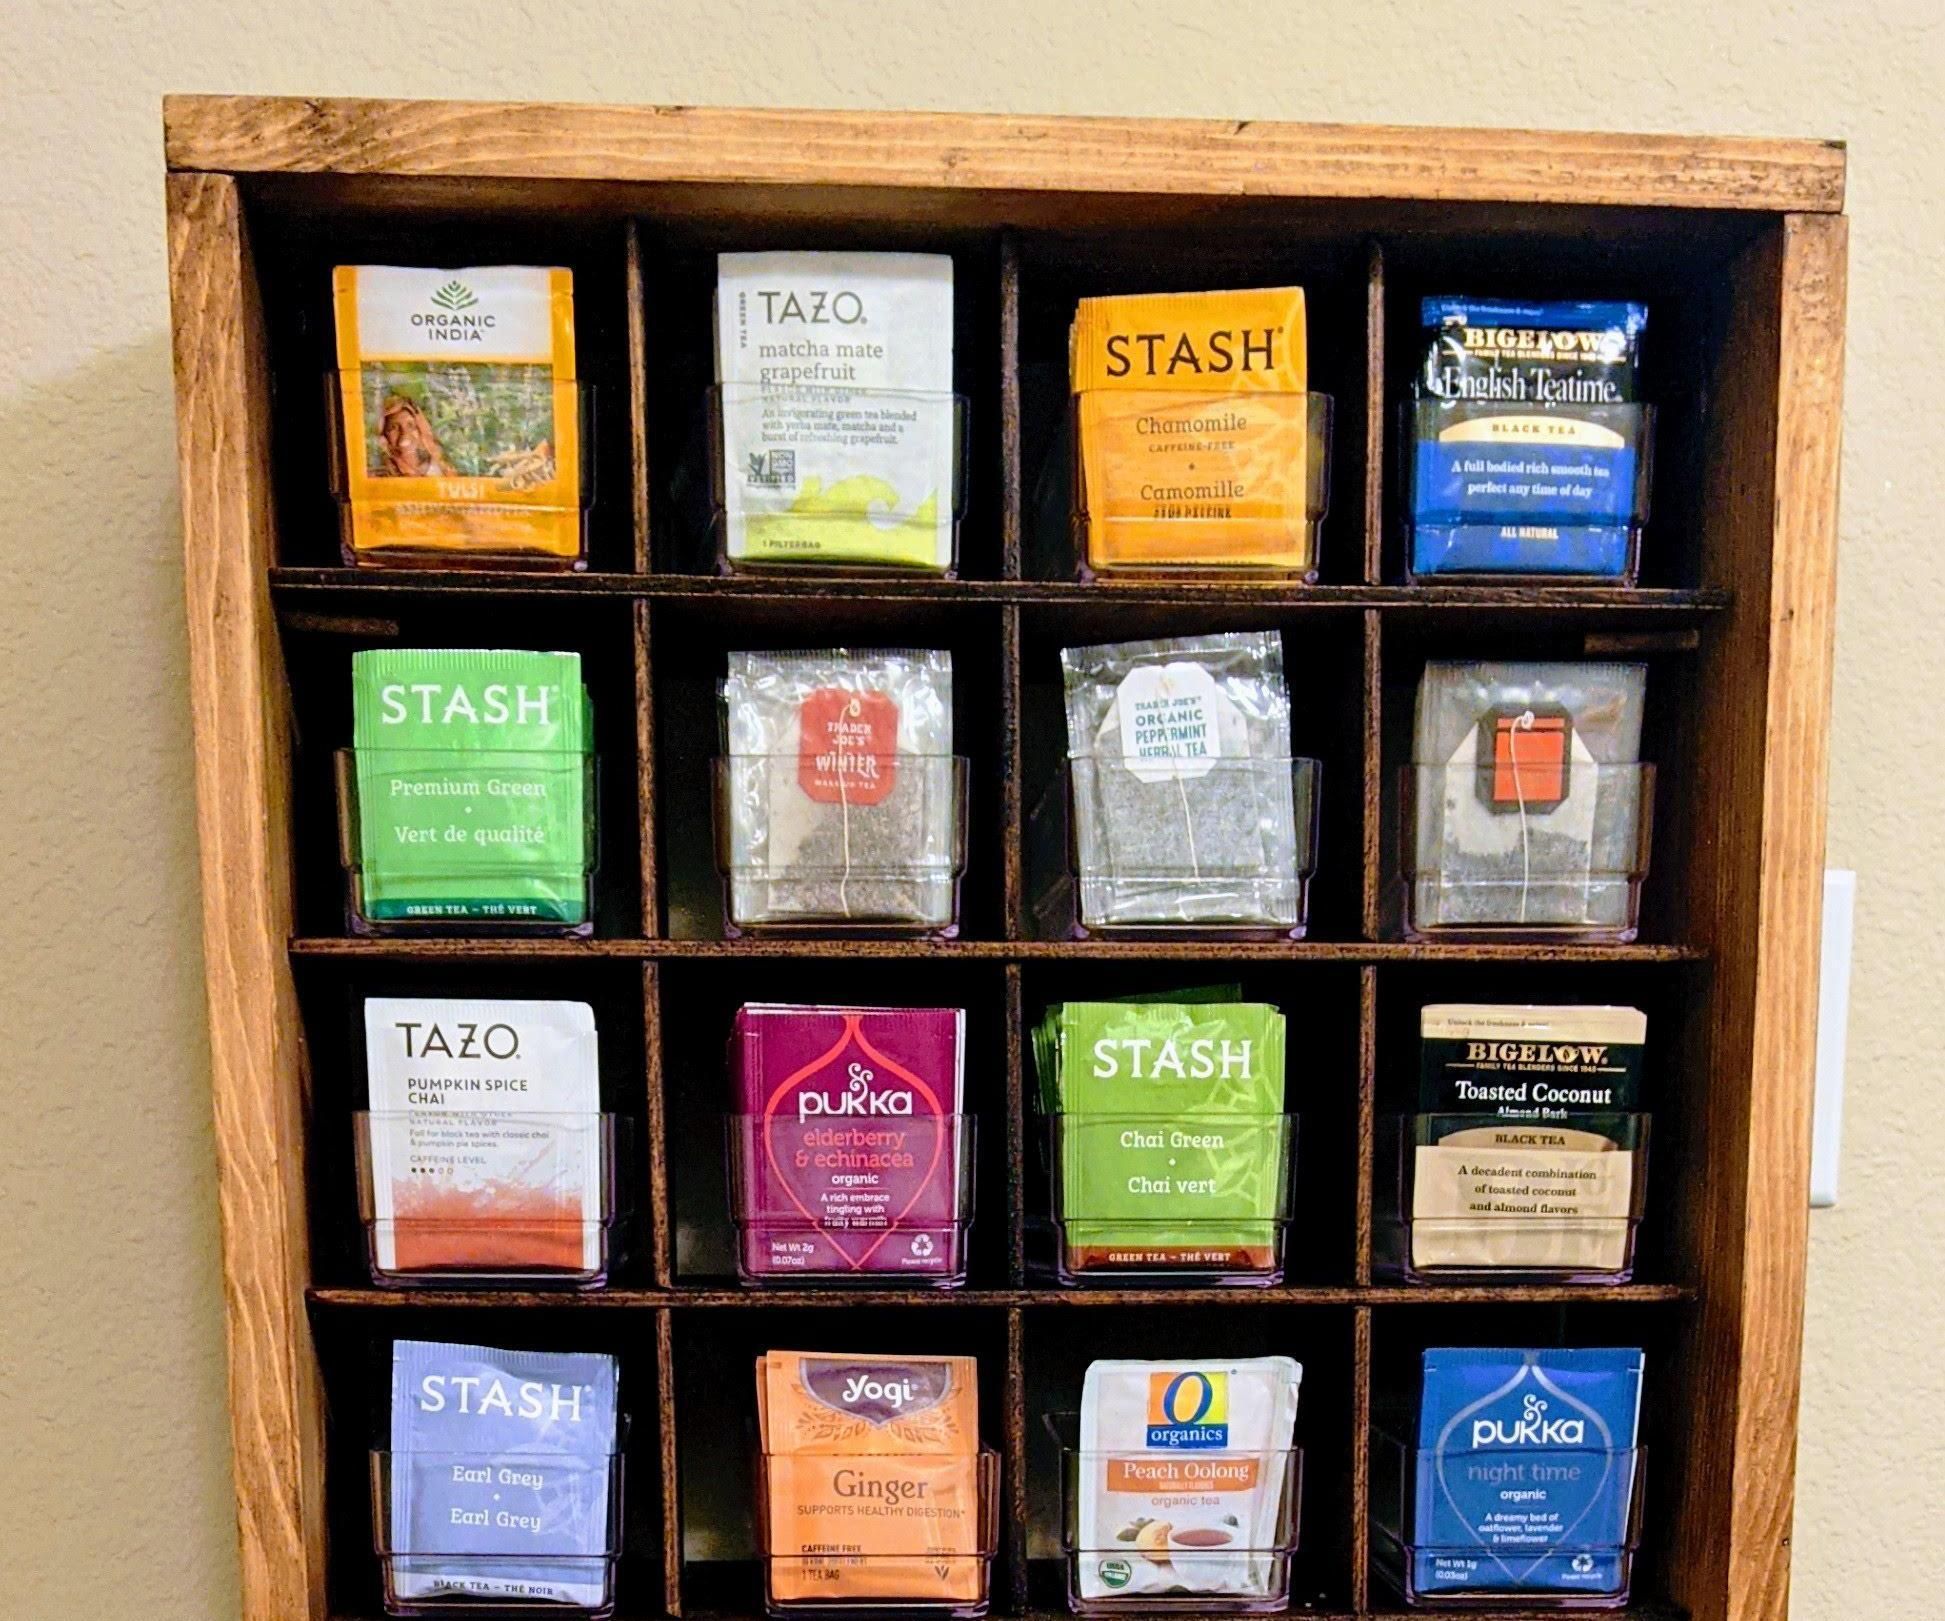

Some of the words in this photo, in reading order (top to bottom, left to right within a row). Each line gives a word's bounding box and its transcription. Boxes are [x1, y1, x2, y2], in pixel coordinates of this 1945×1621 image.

[757, 291, 863, 324] TAZO
[411, 314, 495, 328] ORGANIC
[428, 328, 481, 341] INDIA
[1463, 328, 1605, 351] BIGELOW
[759, 340, 829, 358] matcha
[836, 344, 884, 358] mate
[1107, 328, 1274, 377] STASH
[760, 362, 857, 385] grapefruit
[1444, 366, 1526, 404] English
[1530, 366, 1617, 403] Teatime
[836, 411, 862, 421] green
[864, 411, 878, 419] tea
[880, 410, 917, 421] blended
[1136, 413, 1247, 435] Chamomile
[762, 421, 784, 430] with
[842, 422, 876, 431] matcha
[879, 422, 896, 432] and
[1492, 424, 1540, 433] BLACK
[1549, 425, 1576, 434] TEA
[762, 432, 786, 442] burst
[788, 432, 798, 441] of
[1451, 460, 1461, 473] A
[1464, 459, 1485, 473] full
[1486, 460, 1524, 474] bodied
[1526, 461, 1549, 474] rich
[1551, 463, 1592, 476] smooth
[1140, 480, 1245, 501] Camomille
[1468, 482, 1507, 496] perfect
[1509, 485, 1531, 497] any
[1532, 483, 1557, 496] time
[1559, 484, 1572, 496] of
[1572, 485, 1593, 498] day
[1501, 526, 1517, 538] ALL
[1519, 528, 1559, 539] NATURAL
[381, 684, 550, 725] STASH
[1135, 709, 1203, 726] ORGANIC
[1135, 723, 1206, 744] PEPPRMINT
[1185, 741, 1207, 758] TEA
[816, 751, 880, 779] WINTER
[390, 778, 480, 797] Premium
[487, 779, 547, 797] Green
[394, 825, 438, 843] Vert
[444, 825, 467, 842] de
[474, 825, 545, 846] qualité
[406, 905, 443, 915] GREEN
[445, 905, 469, 915] TEA
[508, 905, 537, 915] VERT
[395, 1023, 519, 1059] TAZO
[1093, 1039, 1252, 1079] STASH
[1466, 1042, 1606, 1065] BIGELOW
[408, 1079, 480, 1091] PUMPKIN
[485, 1079, 528, 1091] SPICE
[799, 1063, 912, 1123] pukka
[1455, 1080, 1527, 1102] Toasted
[1532, 1083, 1612, 1104] Coconut
[408, 1093, 445, 1104] CHAI
[1497, 1106, 1540, 1119] Almond
[1542, 1107, 1568, 1120] Bark
[441, 1130, 463, 1138] black
[502, 1131, 530, 1139] classic
[532, 1131, 550, 1139] chai
[803, 1128, 906, 1148] elderberry
[1120, 1130, 1164, 1149] Chai
[1170, 1131, 1224, 1149] Green
[1495, 1134, 1539, 1144] BLACK
[1541, 1135, 1565, 1145] TEA
[418, 1140, 454, 1148] pumpkin
[456, 1140, 469, 1148] pie
[410, 1155, 455, 1164] CAFFEINE
[457, 1156, 487, 1164] LEVEL
[795, 1152, 809, 1168] &
[814, 1151, 914, 1169] echinacea
[831, 1173, 879, 1186] organic
[1458, 1165, 1468, 1175] A
[1471, 1166, 1522, 1178] decadent
[1525, 1168, 1596, 1180] combination
[1128, 1176, 1170, 1194] Chai
[1176, 1176, 1217, 1193] vert
[1474, 1184, 1486, 1195] of
[1486, 1185, 1529, 1196] toasted
[1532, 1187, 1576, 1197] coconut
[821, 1193, 829, 1202] A
[830, 1193, 848, 1202] rich
[850, 1193, 890, 1202] embrace
[826, 1205, 863, 1215] tingling
[864, 1205, 884, 1214] with
[1469, 1202, 1491, 1212] and
[1494, 1202, 1536, 1213] almond
[1540, 1203, 1578, 1214] flavors
[772, 1242, 787, 1251] Net
[802, 1243, 814, 1253] 2g
[1108, 1252, 1143, 1262] GREEN
[1146, 1252, 1166, 1261] TEA
[1204, 1252, 1231, 1261] VERT
[420, 1375, 582, 1422] STASH
[1163, 1371, 1213, 1425] O
[1472, 1394, 1584, 1448] pukka
[1152, 1426, 1223, 1444] organics
[453, 1466, 491, 1484] Earl
[499, 1468, 543, 1490] Grey
[1124, 1462, 1179, 1479] Peach
[1184, 1462, 1249, 1481] Oolong
[1468, 1461, 1524, 1485] night
[1532, 1461, 1581, 1481] time
[833, 1470, 928, 1505] Ginger
[1500, 1489, 1547, 1502] organic
[1152, 1496, 1196, 1508] organic
[1201, 1496, 1220, 1505] tea
[797, 1506, 853, 1516] SUPPORTS
[858, 1506, 903, 1516] HEALTHY
[1485, 1513, 1493, 1522] A
[1494, 1513, 1528, 1523] dreamy
[1530, 1513, 1547, 1522] bed
[1549, 1513, 1559, 1522] of
[450, 1508, 489, 1526] Earl
[497, 1511, 541, 1532] Grey
[1524, 1524, 1564, 1533] lavender
[1501, 1534, 1548, 1543] limeflower
[1435, 1558, 1451, 1568] Net
[433, 1580, 465, 1590] BLACK
[470, 1581, 490, 1590] TEA
[529, 1586, 553, 1595] NOIR
